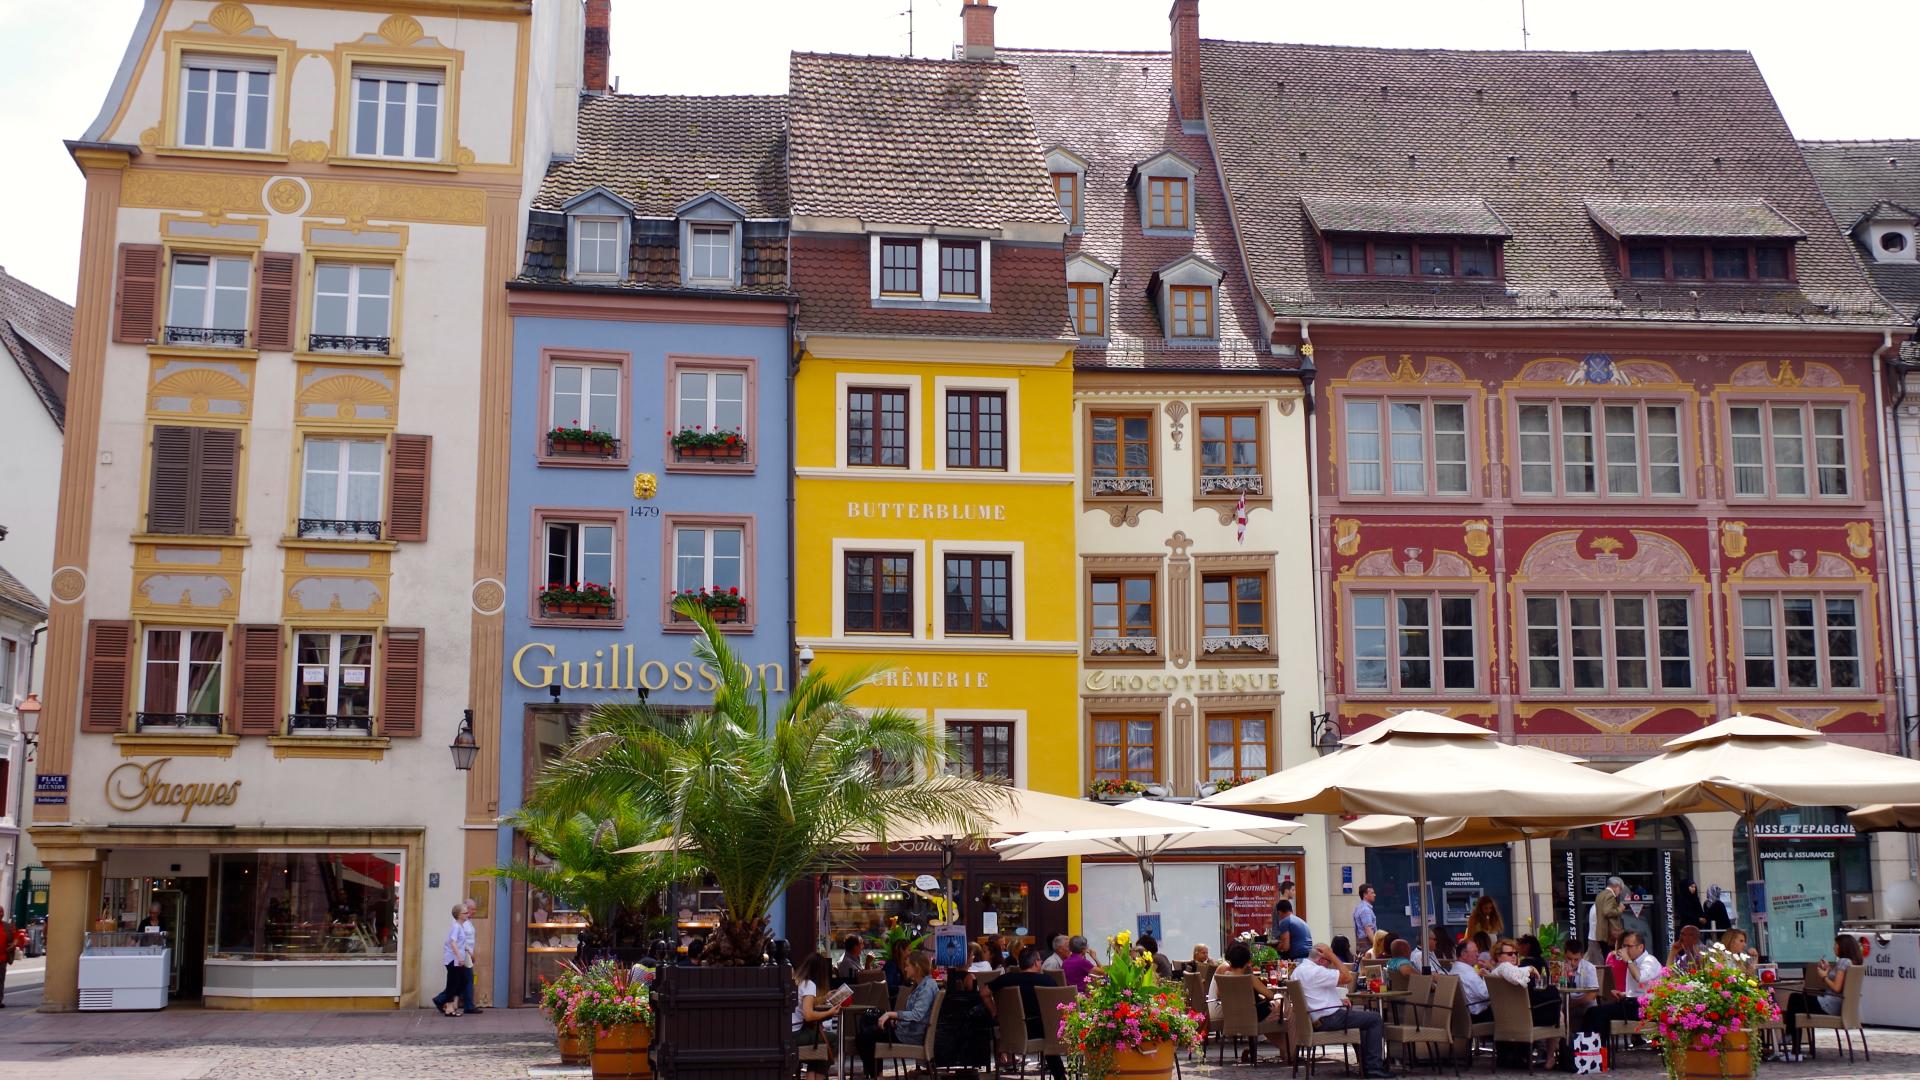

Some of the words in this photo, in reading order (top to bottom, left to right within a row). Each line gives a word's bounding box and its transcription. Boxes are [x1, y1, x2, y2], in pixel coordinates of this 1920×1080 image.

[631, 505, 659, 517] 1479
[847, 502, 1005, 520] BUTTERBLUME
[1086, 669, 1280, 692] CHOCOTHÈQUE
[105, 757, 242, 823] Jacques
[1745, 824, 1786, 834] AISSE
[1449, 850, 1503, 860] AUTOMATIQUE
[1566, 852, 1575, 906] PARTICULIERS
[1664, 851, 1673, 912] PROFESSIONNELS
[1876, 953, 1891, 964] Café
[1864, 965, 1894, 978] illaume
[1898, 965, 1917, 979] Tell
